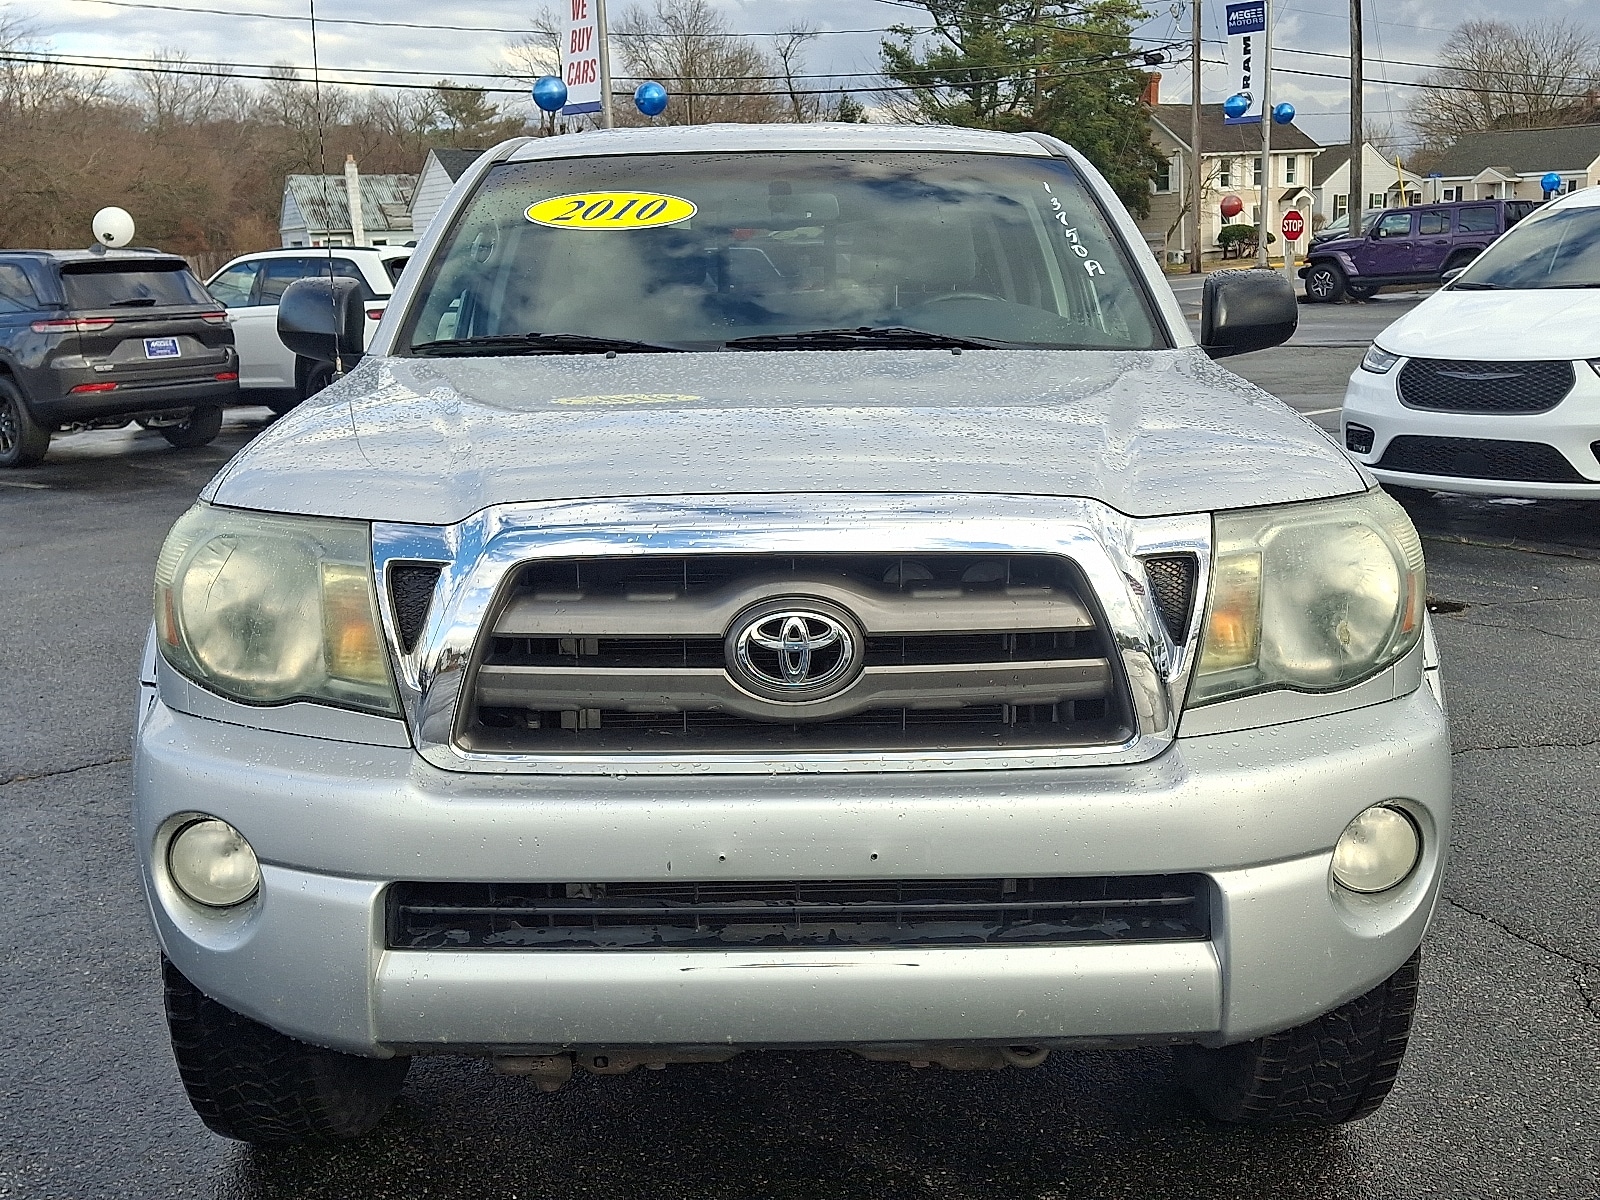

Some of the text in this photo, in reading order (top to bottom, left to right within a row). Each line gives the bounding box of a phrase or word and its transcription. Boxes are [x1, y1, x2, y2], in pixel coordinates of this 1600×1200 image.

[571, 0, 587, 21] WE
[1229, 8, 1263, 21] MEGEE
[1229, 17, 1263, 27] MOTORS
[570, 26, 593, 54] BUY
[567, 58, 597, 86] CARS
[1242, 35, 1251, 90] RAM
[549, 198, 668, 222] 2010
[1043, 181, 1106, 277] 13750A
[1282, 219, 1303, 232] STOP
